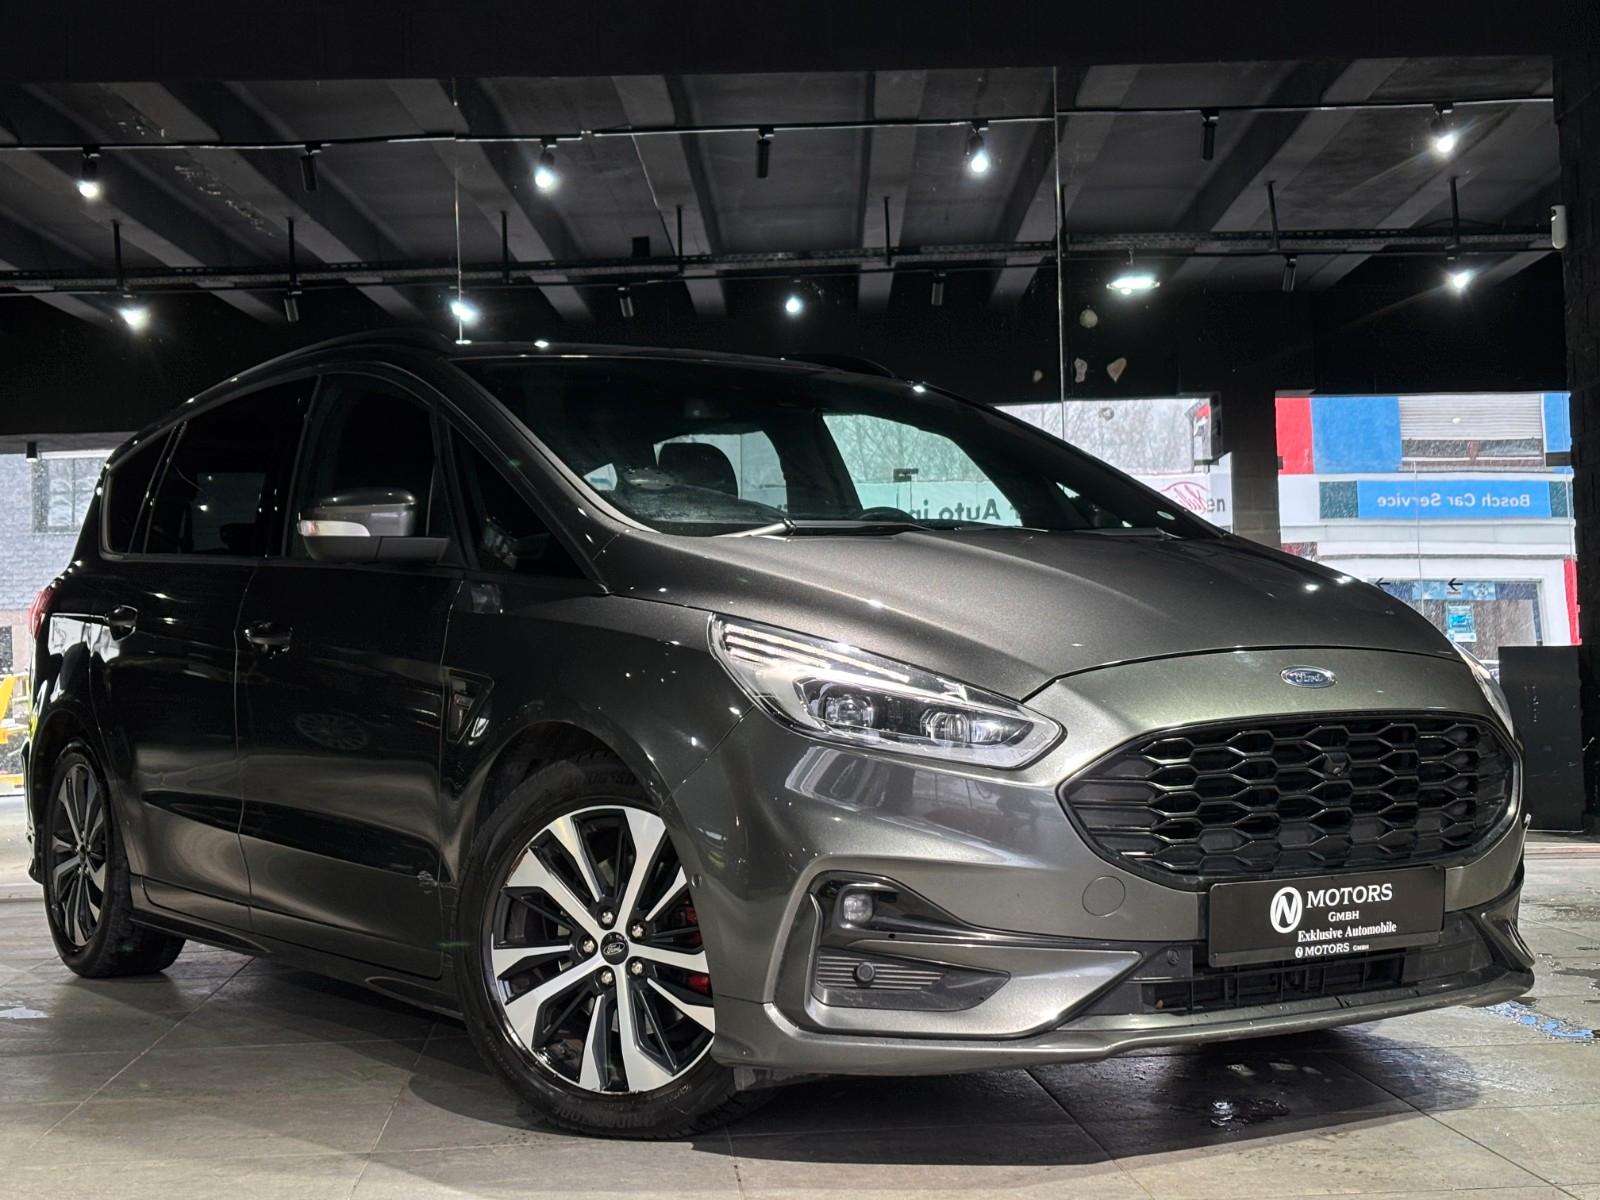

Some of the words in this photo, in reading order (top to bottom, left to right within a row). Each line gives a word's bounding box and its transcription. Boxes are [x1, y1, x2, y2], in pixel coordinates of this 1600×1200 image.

[1306, 884, 1393, 908] MOTORS
[1328, 910, 1360, 922] GMBH
[1298, 928, 1343, 942] Exklusive
[1345, 922, 1397, 938] Automobile
[1305, 943, 1350, 957] MOTORS
